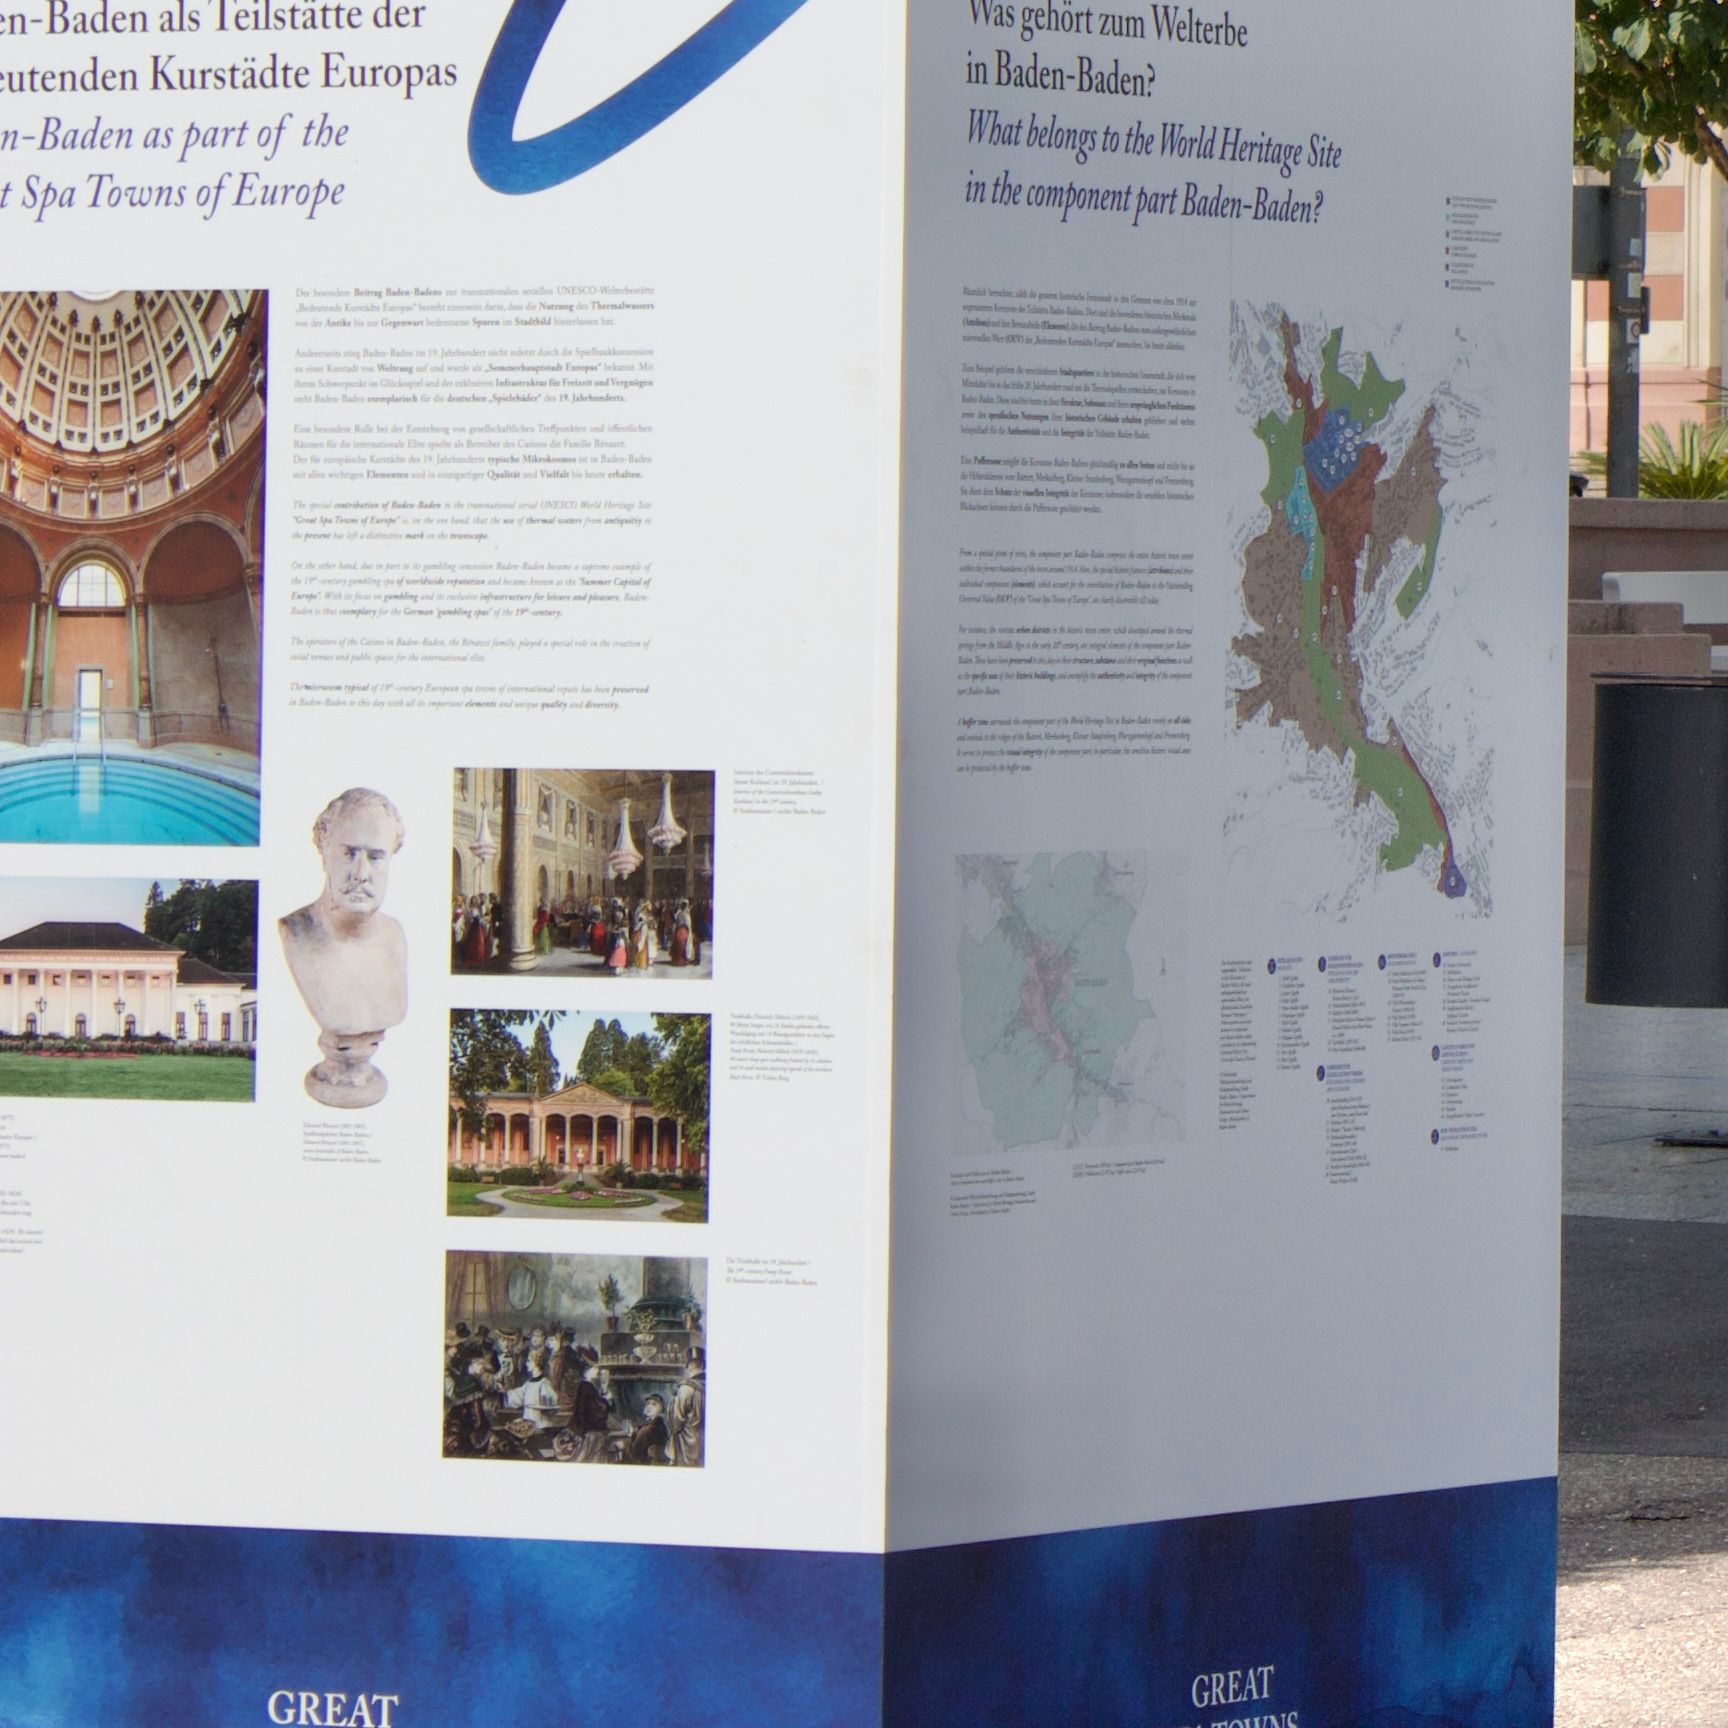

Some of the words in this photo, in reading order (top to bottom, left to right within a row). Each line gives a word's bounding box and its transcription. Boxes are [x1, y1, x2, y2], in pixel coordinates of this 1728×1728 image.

[1098, 12, 1146, 39] zum
[1150, 3, 1248, 48] Welterbe
[149, 52, 310, 91] Kurstädte
[320, 51, 458, 100] Europas
[966, 49, 989, 85] in
[994, 48, 1156, 98] Baden-Baden?
[0, 115, 133, 152] n-Baden
[142, 127, 174, 149] as
[176, 120, 250, 163] part
[256, 112, 294, 161] of
[301, 112, 350, 148] the
[968, 108, 1024, 147] What
[1026, 112, 1098, 166] belongs
[1101, 125, 1120, 153] to
[1124, 119, 1155, 156] the
[1160, 122, 1218, 160] World
[1218, 126, 1303, 179] Heritage
[1306, 132, 1342, 169] Site
[0, 181, 13, 209] t
[20, 175, 76, 223] Spa
[86, 173, 187, 208] Towns
[196, 171, 233, 221] of
[231, 171, 346, 220] Europe
[965, 169, 986, 204] in
[991, 169, 1023, 206] the
[1026, 180, 1133, 223] component
[1131, 185, 1179, 228] part
[1180, 181, 1324, 224] Baden-Baden?
[267, 1690, 399, 1728] GREAT
[1191, 1664, 1275, 1708] GREAT
